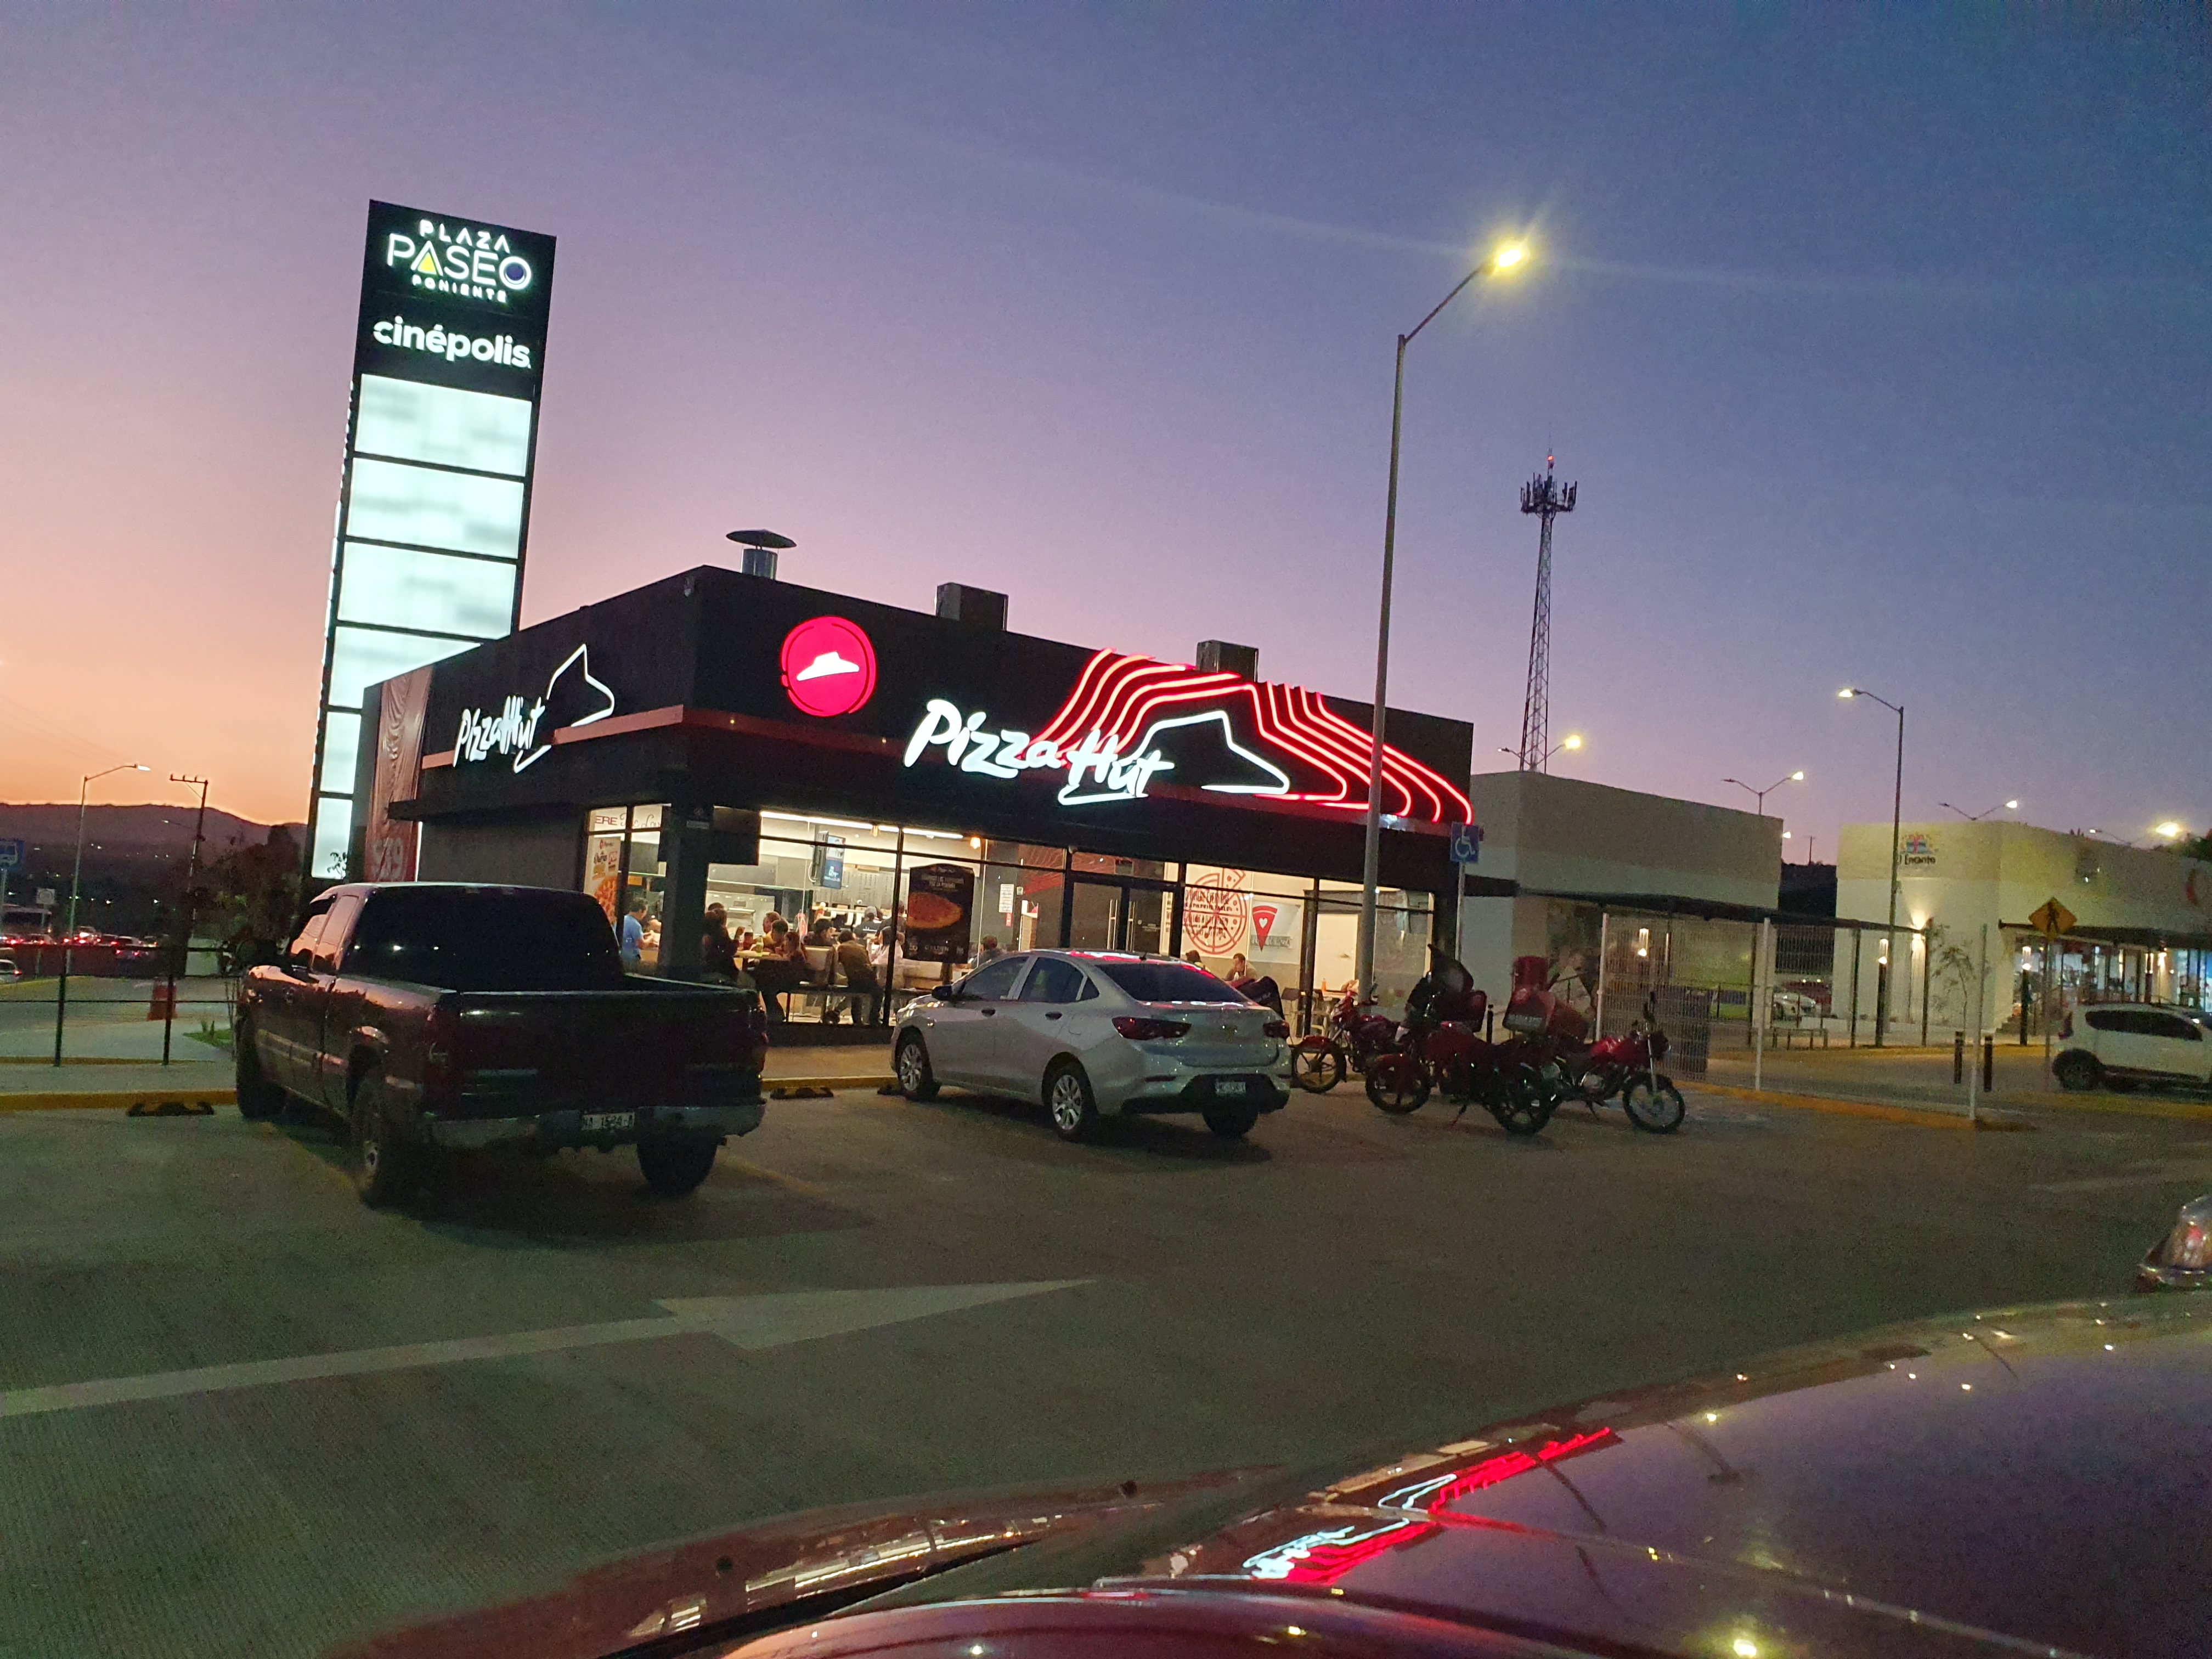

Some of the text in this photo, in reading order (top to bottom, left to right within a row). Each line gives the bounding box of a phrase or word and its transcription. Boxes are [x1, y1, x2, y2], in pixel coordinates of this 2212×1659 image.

[386, 233, 532, 290] PASEO
[419, 219, 511, 254] PLAZA
[411, 274, 508, 303] PONIENTE
[373, 315, 532, 369] cinépolis
[453, 708, 501, 768] Pizza
[904, 699, 1175, 796] Pizza Hut
